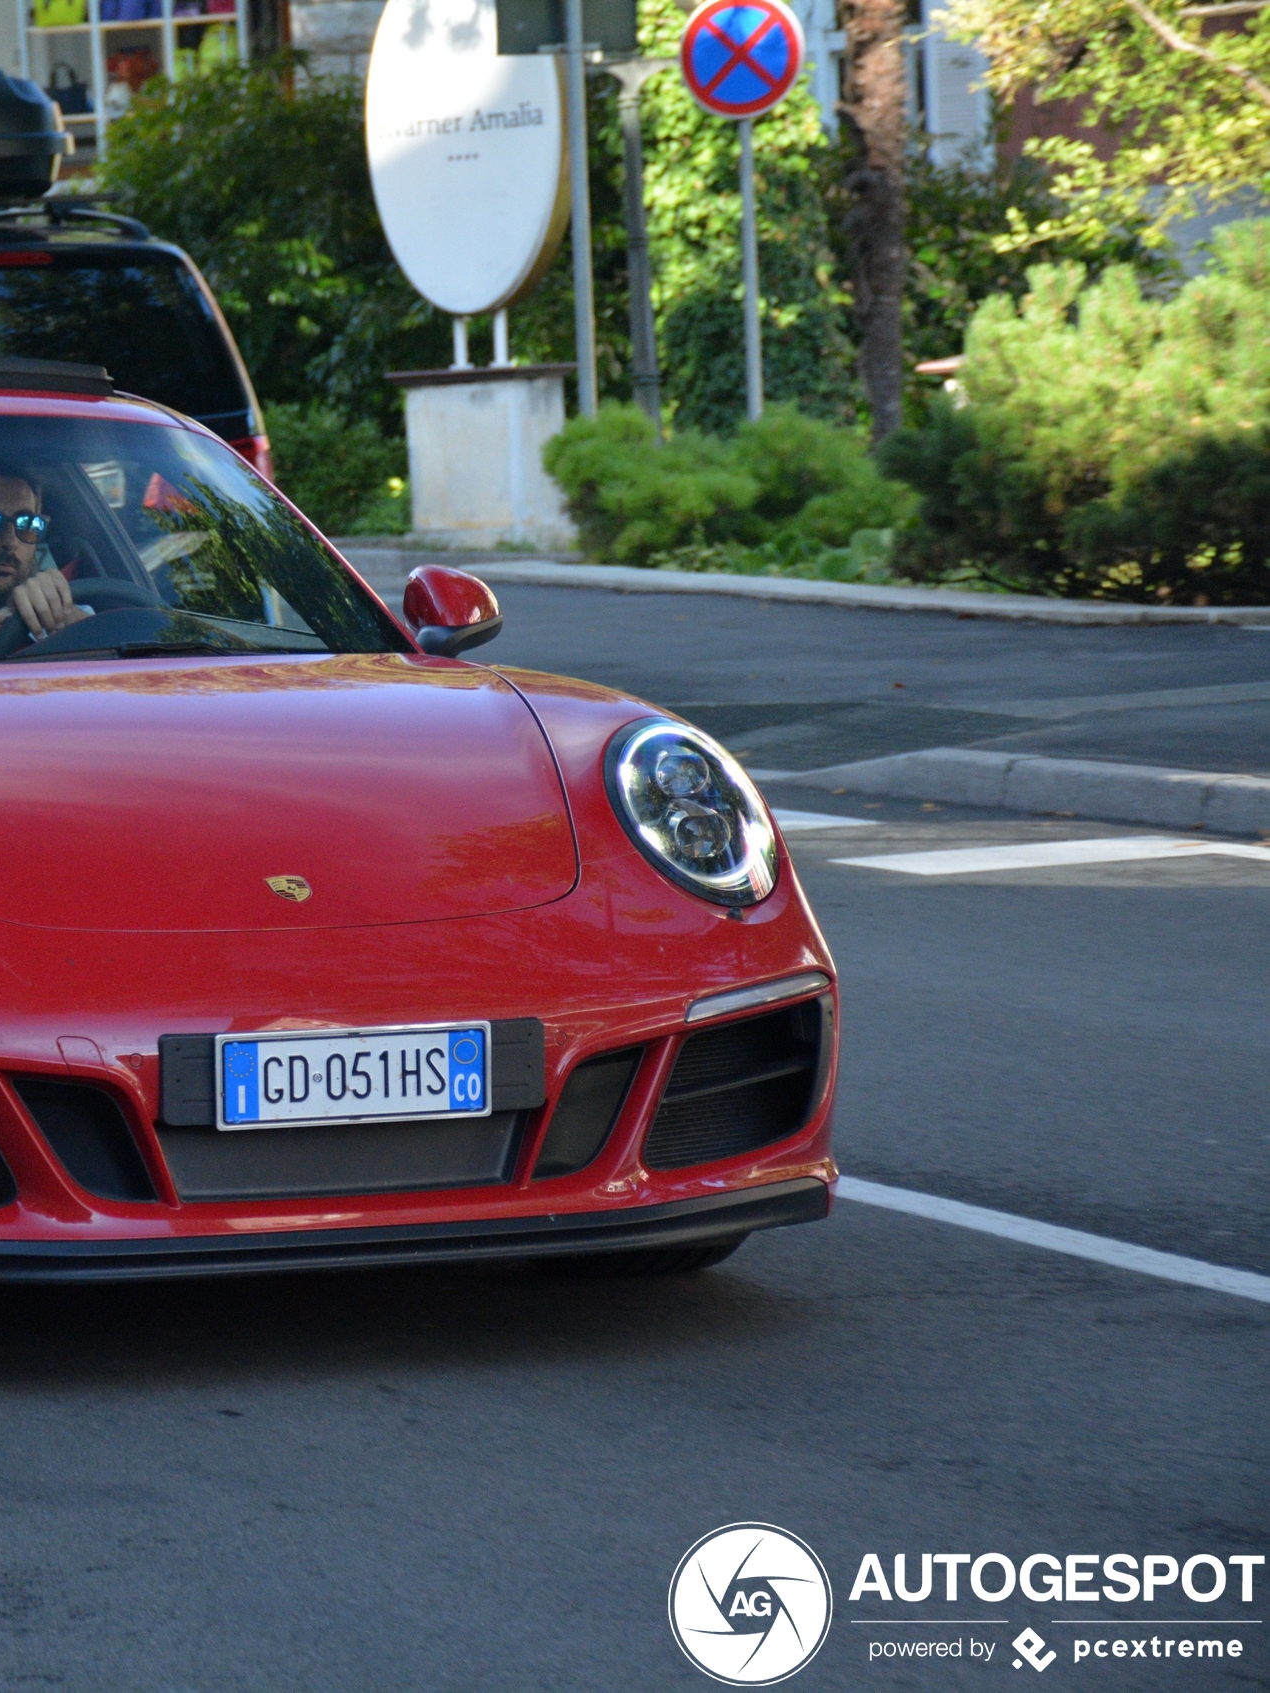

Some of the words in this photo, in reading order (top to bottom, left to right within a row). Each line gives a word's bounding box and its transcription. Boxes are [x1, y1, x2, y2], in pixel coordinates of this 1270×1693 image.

[376, 116, 462, 139] arner
[263, 1054, 310, 1104] GD
[326, 1047, 447, 1101] 051HS
[453, 1072, 481, 1102] CO
